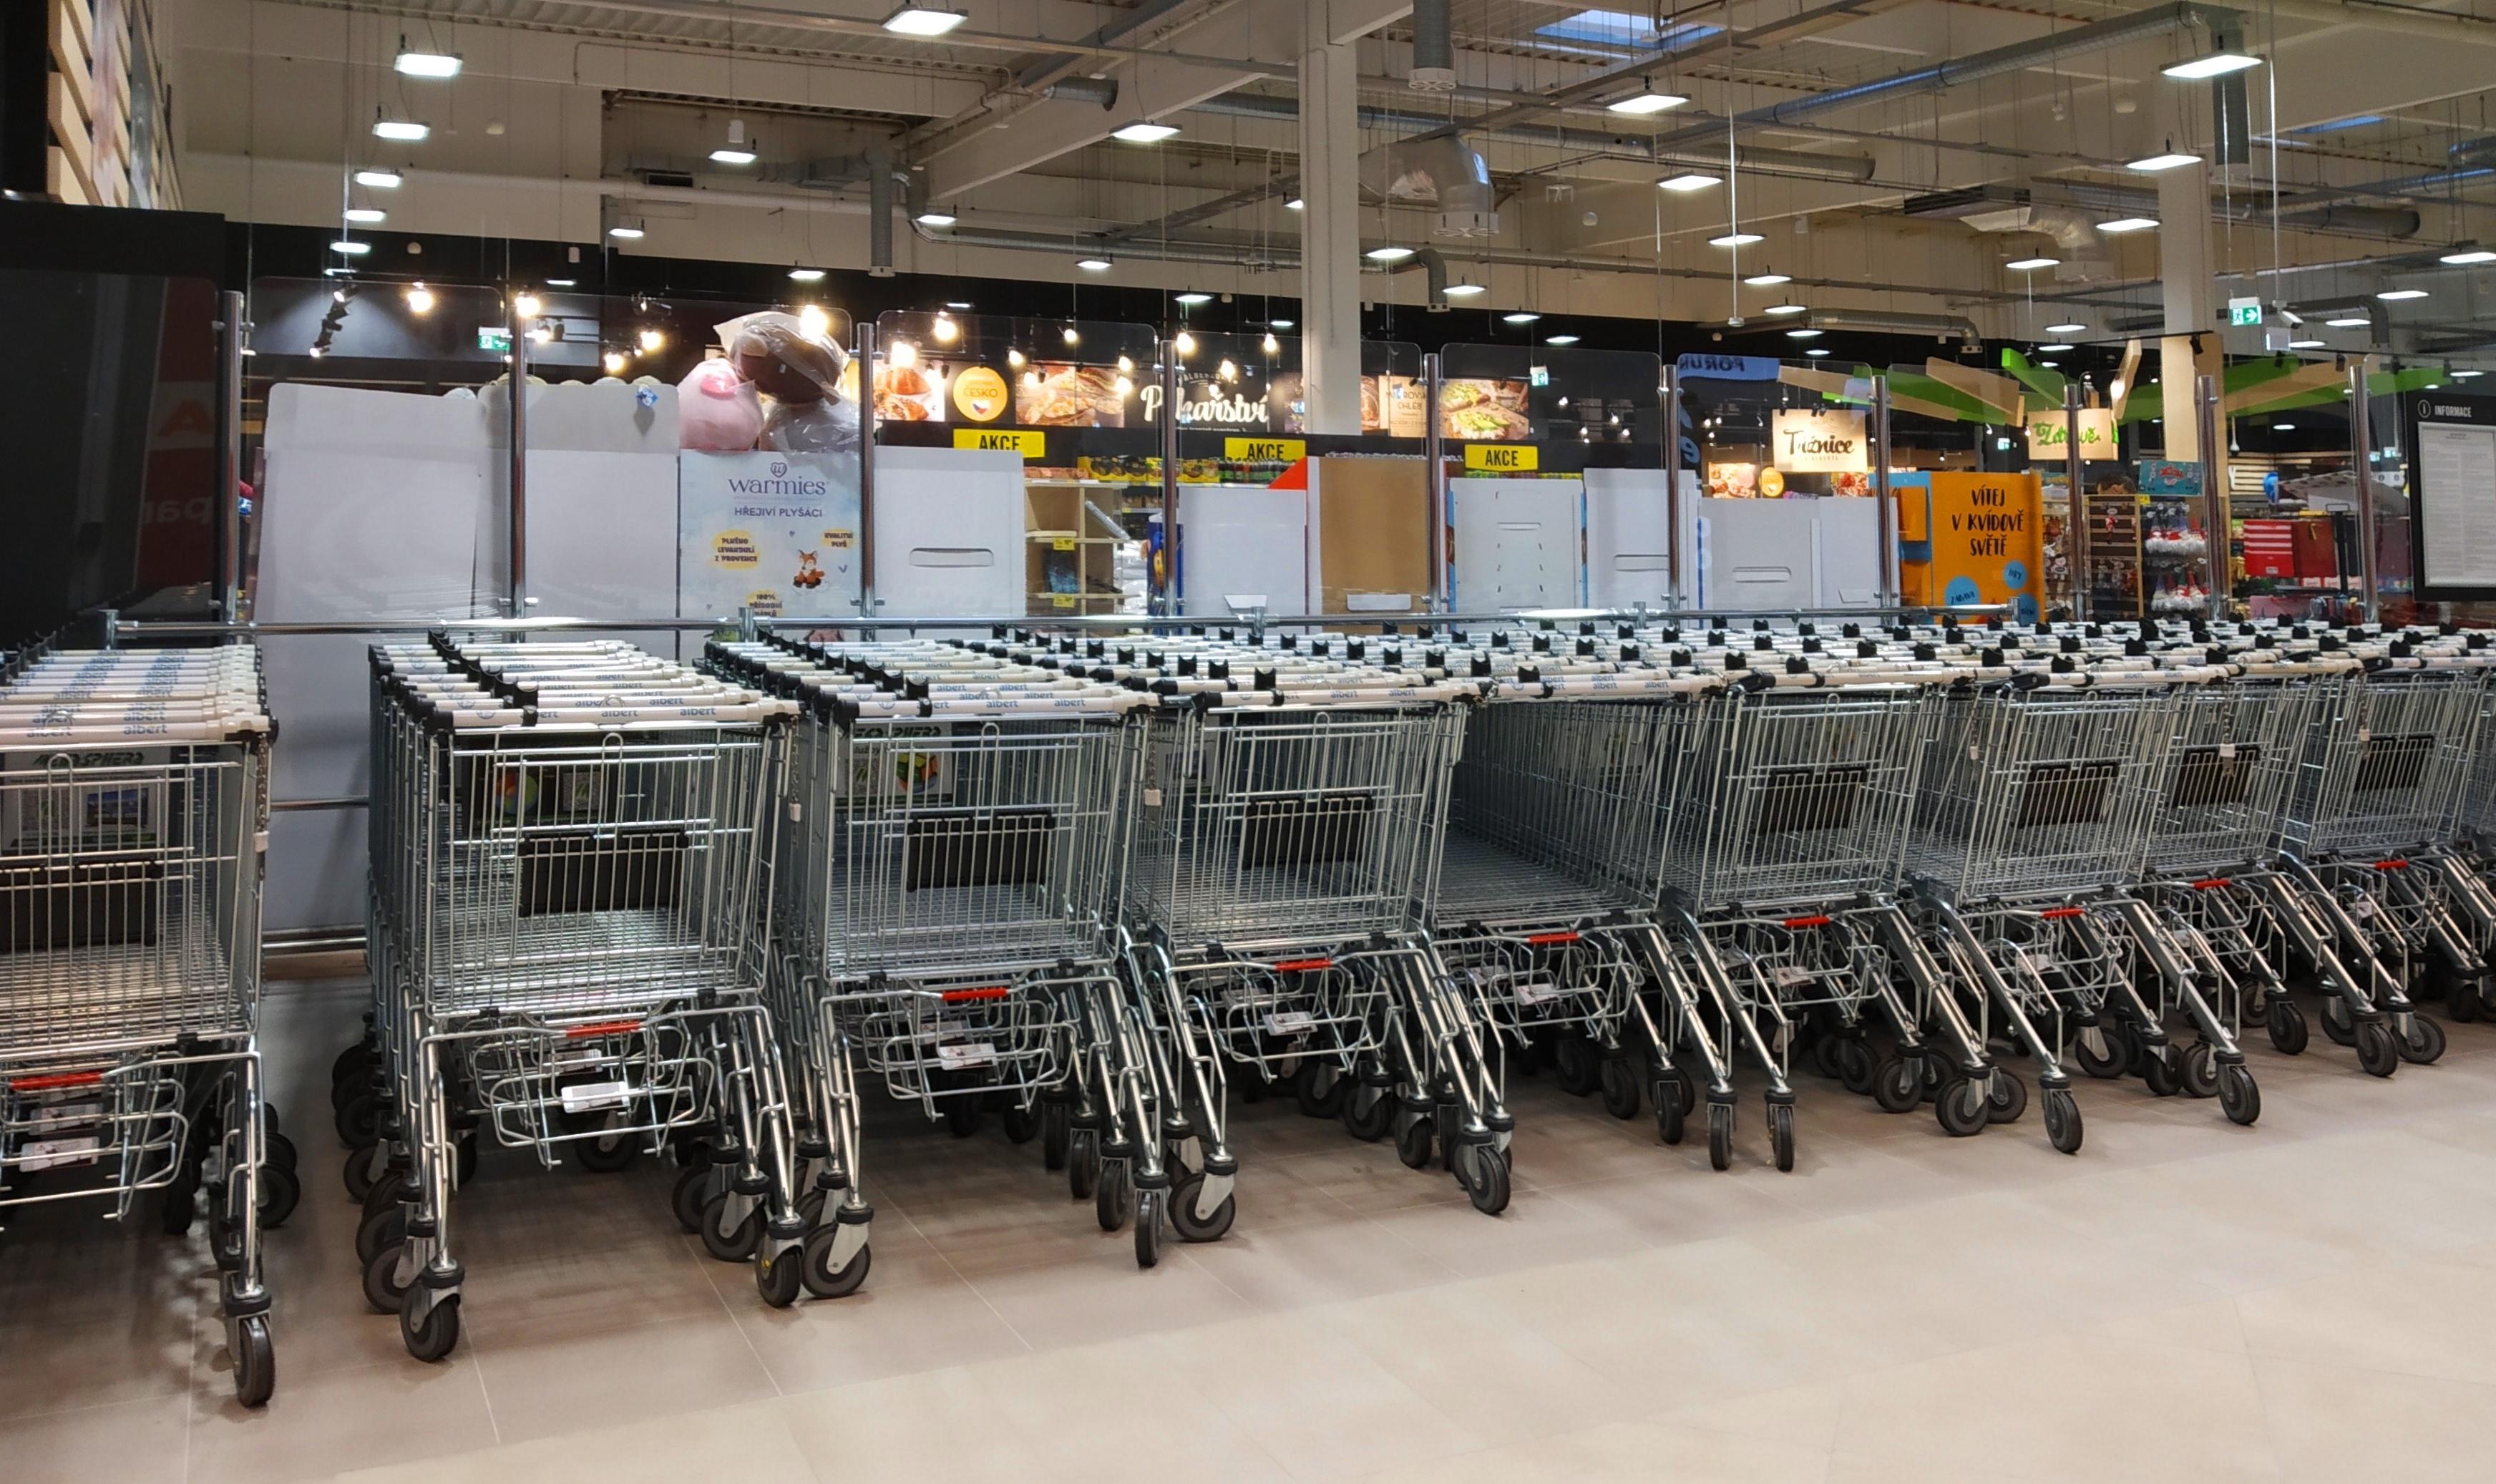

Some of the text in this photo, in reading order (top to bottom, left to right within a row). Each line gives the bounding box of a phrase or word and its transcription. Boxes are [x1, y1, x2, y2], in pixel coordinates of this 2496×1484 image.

[1140, 384, 1269, 423] Pkařství
[2434, 405, 2472, 418] INFORMACE
[979, 434, 1020, 451] AKCE
[1247, 443, 1285, 460] AKCE
[1485, 449, 1518, 467] AKCE
[1971, 484, 2006, 507] VÍTEJ
[734, 504, 823, 518] HŘEJIVÍ PLYŠÁCI
[1951, 509, 2024, 532] V KVÍDOVĚ
[1970, 534, 2008, 557] SVĚTĚ
[1593, 680, 1617, 689] albert
[1644, 680, 1669, 688] albert
[1330, 689, 1359, 698] albert
[1388, 688, 1416, 697] albert
[986, 699, 1019, 708] albert
[1054, 698, 1086, 707] albert
[123, 711, 165, 721] albert
[601, 708, 638, 717] albert
[680, 706, 716, 716] albert
[26, 726, 72, 738] albert
[123, 723, 167, 735] albert
